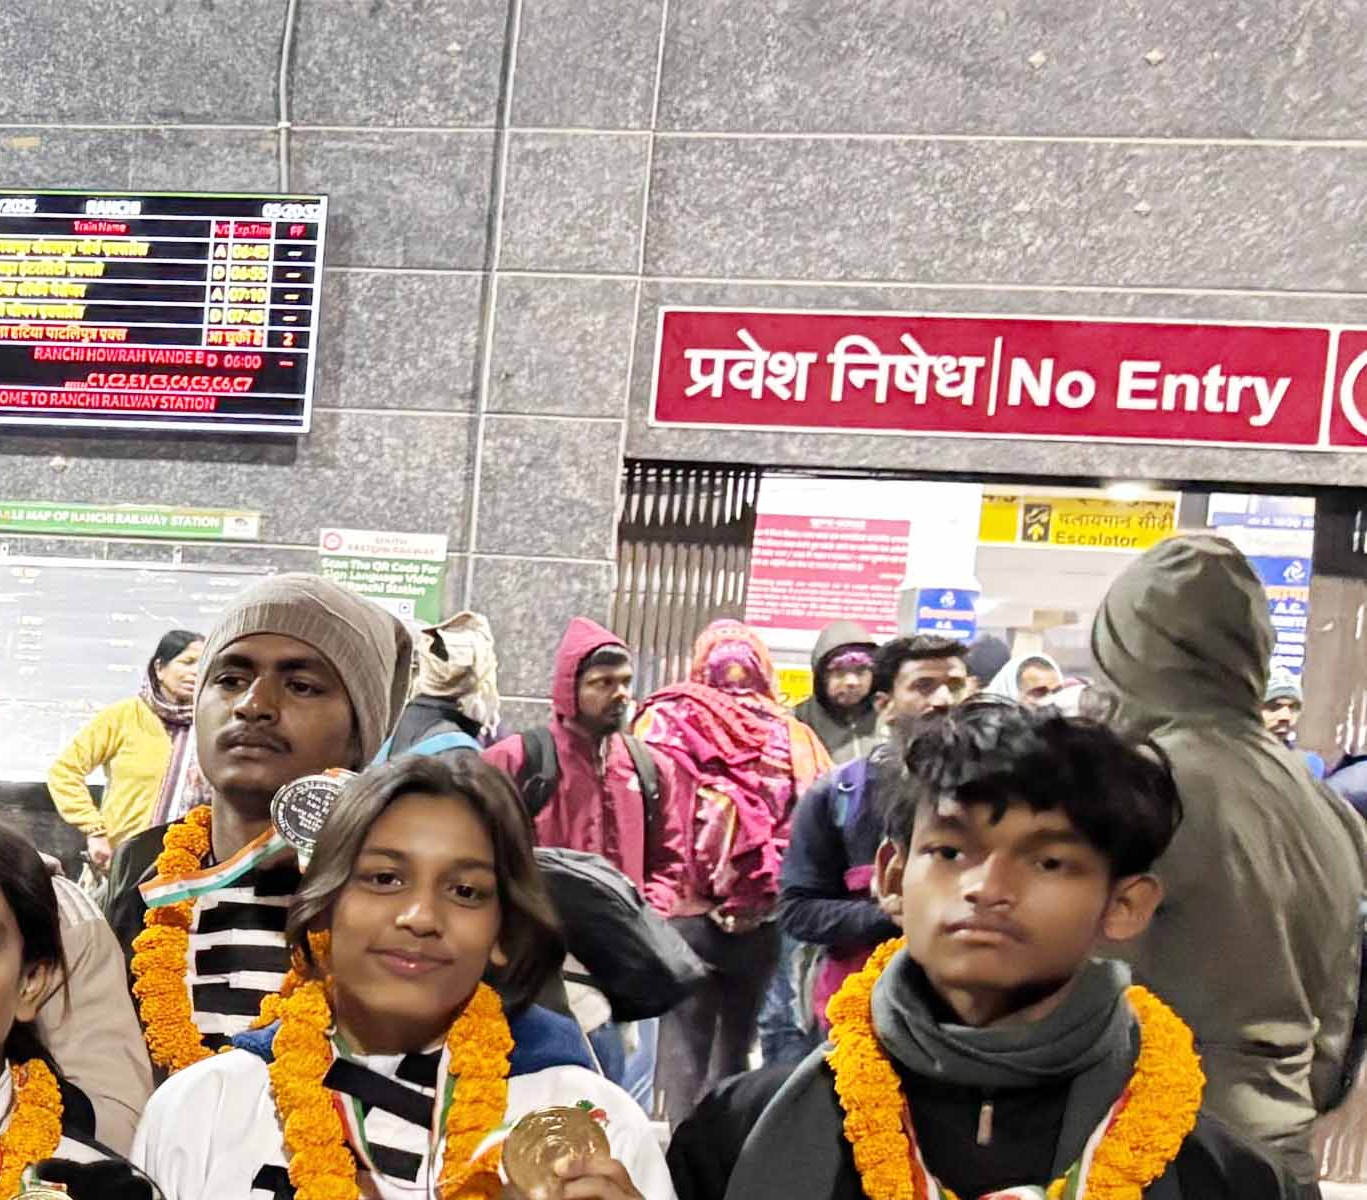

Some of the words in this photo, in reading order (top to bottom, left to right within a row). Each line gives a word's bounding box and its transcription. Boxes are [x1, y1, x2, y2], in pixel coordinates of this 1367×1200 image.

[74, 220, 98, 232] Train
[98, 221, 127, 233] Name
[214, 245, 227, 259] A
[210, 288, 223, 301] A
[282, 333, 293, 346] 2
[34, 347, 84, 361] RANCHI
[87, 349, 147, 363] HOWRAH
[148, 350, 193, 364] VANDE
[207, 356, 218, 368] D
[223, 355, 262, 369] 06:00
[684, 329, 818, 401] प्रवेश
[827, 333, 986, 406] निषेध
[1008, 357, 1096, 409] No
[1116, 360, 1292, 427] Entry
[30, 391, 47, 404] TO
[49, 392, 100, 406] RANCHI
[102, 394, 158, 409] RAILWAY
[159, 396, 216, 411] STATION
[170, 515, 220, 528] STATION
[1055, 531, 1138, 547] Escalator
